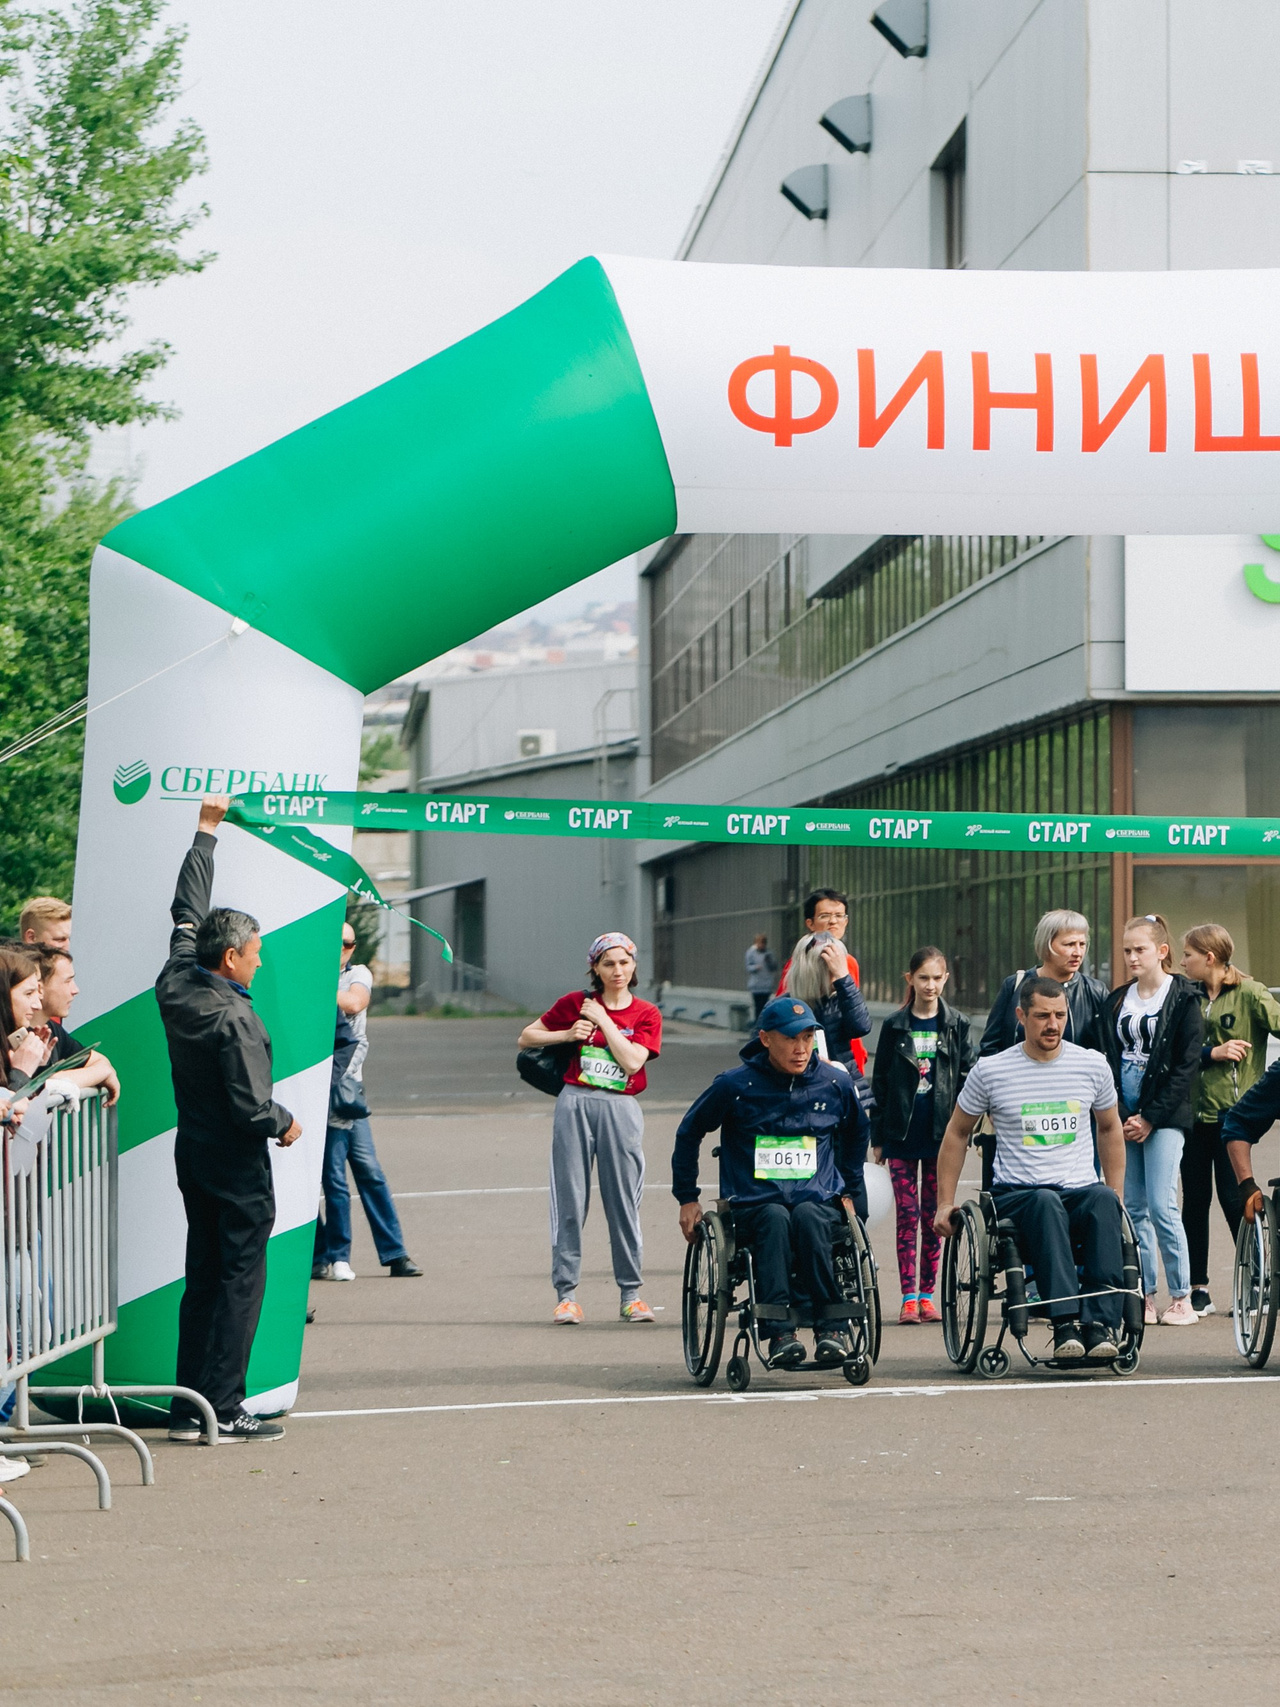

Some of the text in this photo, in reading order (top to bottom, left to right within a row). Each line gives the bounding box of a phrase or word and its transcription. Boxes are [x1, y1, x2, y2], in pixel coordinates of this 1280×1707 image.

[160, 766, 329, 794] СБЕРБАНК
[263, 795, 328, 817] СТАРТ
[425, 801, 489, 824] СТАРТ
[568, 807, 632, 830] СТАРТ
[727, 813, 790, 836] СТАРТ
[869, 817, 932, 839] СТАРТ
[1028, 821, 1091, 843] СТАРТ
[1168, 824, 1230, 845] СТАРТ
[1041, 1116, 1077, 1131] 0618
[774, 1152, 811, 1166] 0617
